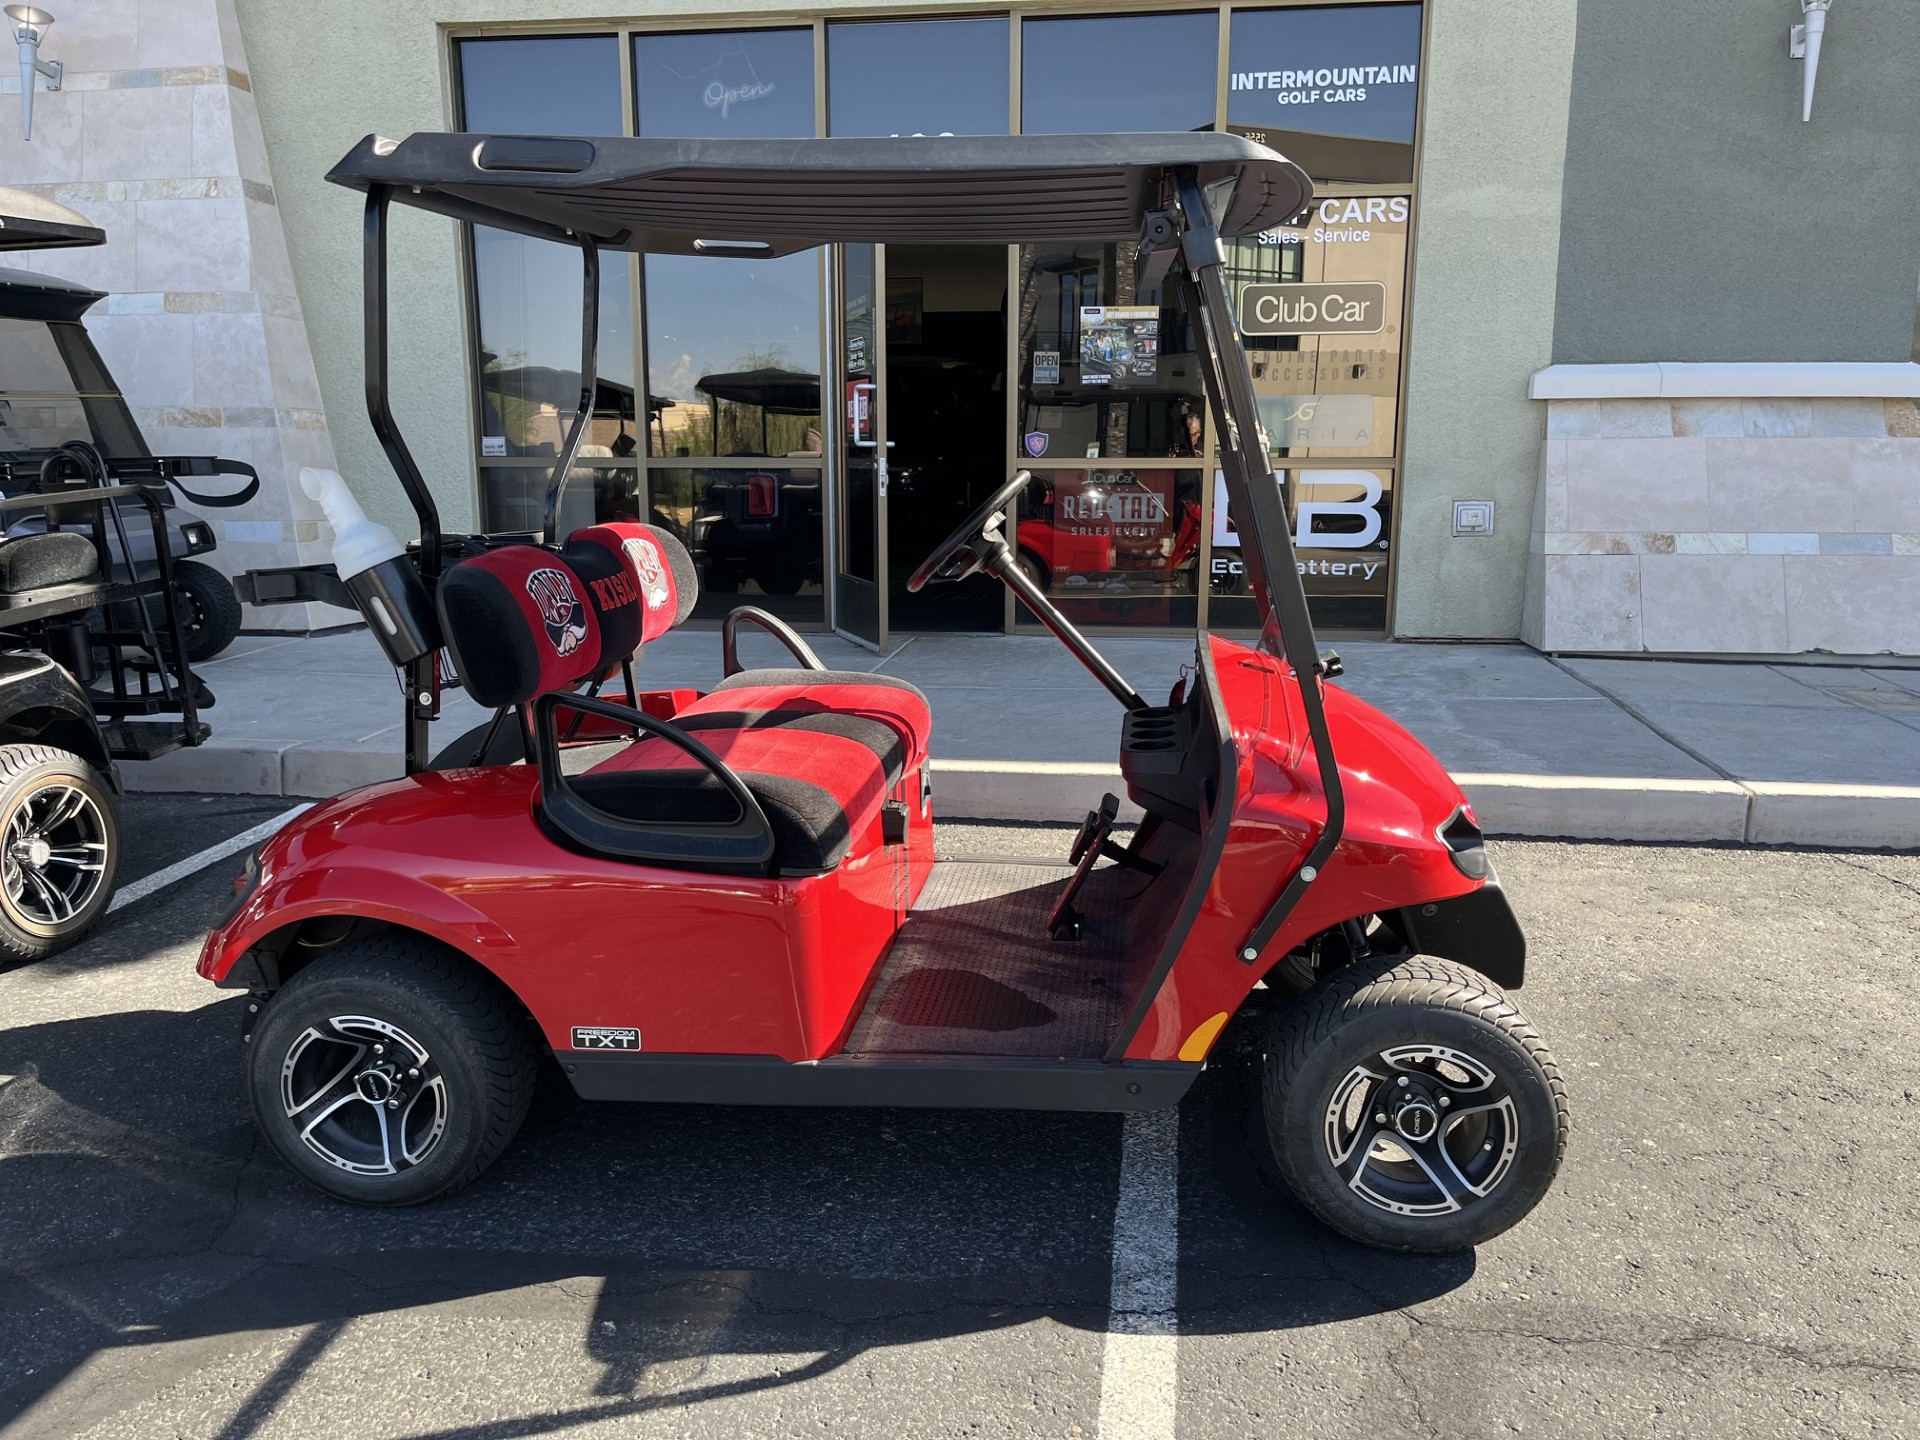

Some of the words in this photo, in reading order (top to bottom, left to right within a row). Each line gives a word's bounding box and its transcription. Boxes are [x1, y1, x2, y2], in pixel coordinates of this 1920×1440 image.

[1231, 65, 1416, 90] INTERMOUNTAIN
[703, 81, 774, 118] Open
[1277, 91, 1320, 105] GOLF
[1323, 88, 1367, 102] CARS
[1319, 197, 1409, 224] CARS
[1257, 229, 1300, 245] Sales
[1313, 228, 1371, 243] Service
[1255, 295, 1318, 323] Club
[1321, 294, 1371, 322] Car
[1035, 355, 1058, 366] OPEN
[1251, 350, 1317, 364] ENUINE
[1330, 348, 1387, 362] PARTS
[1268, 428, 1369, 441] ARIA
[1093, 473, 1116, 483] Club
[1116, 473, 1134, 483] Car
[1063, 495, 1105, 519] RED
[1118, 495, 1159, 520] TAG
[1071, 526, 1110, 536] SALES
[1115, 527, 1156, 536] EVENT
[1211, 558, 1244, 574] Ec
[576, 1029, 635, 1037] FREEDOM
[576, 1034, 636, 1048] TXT
